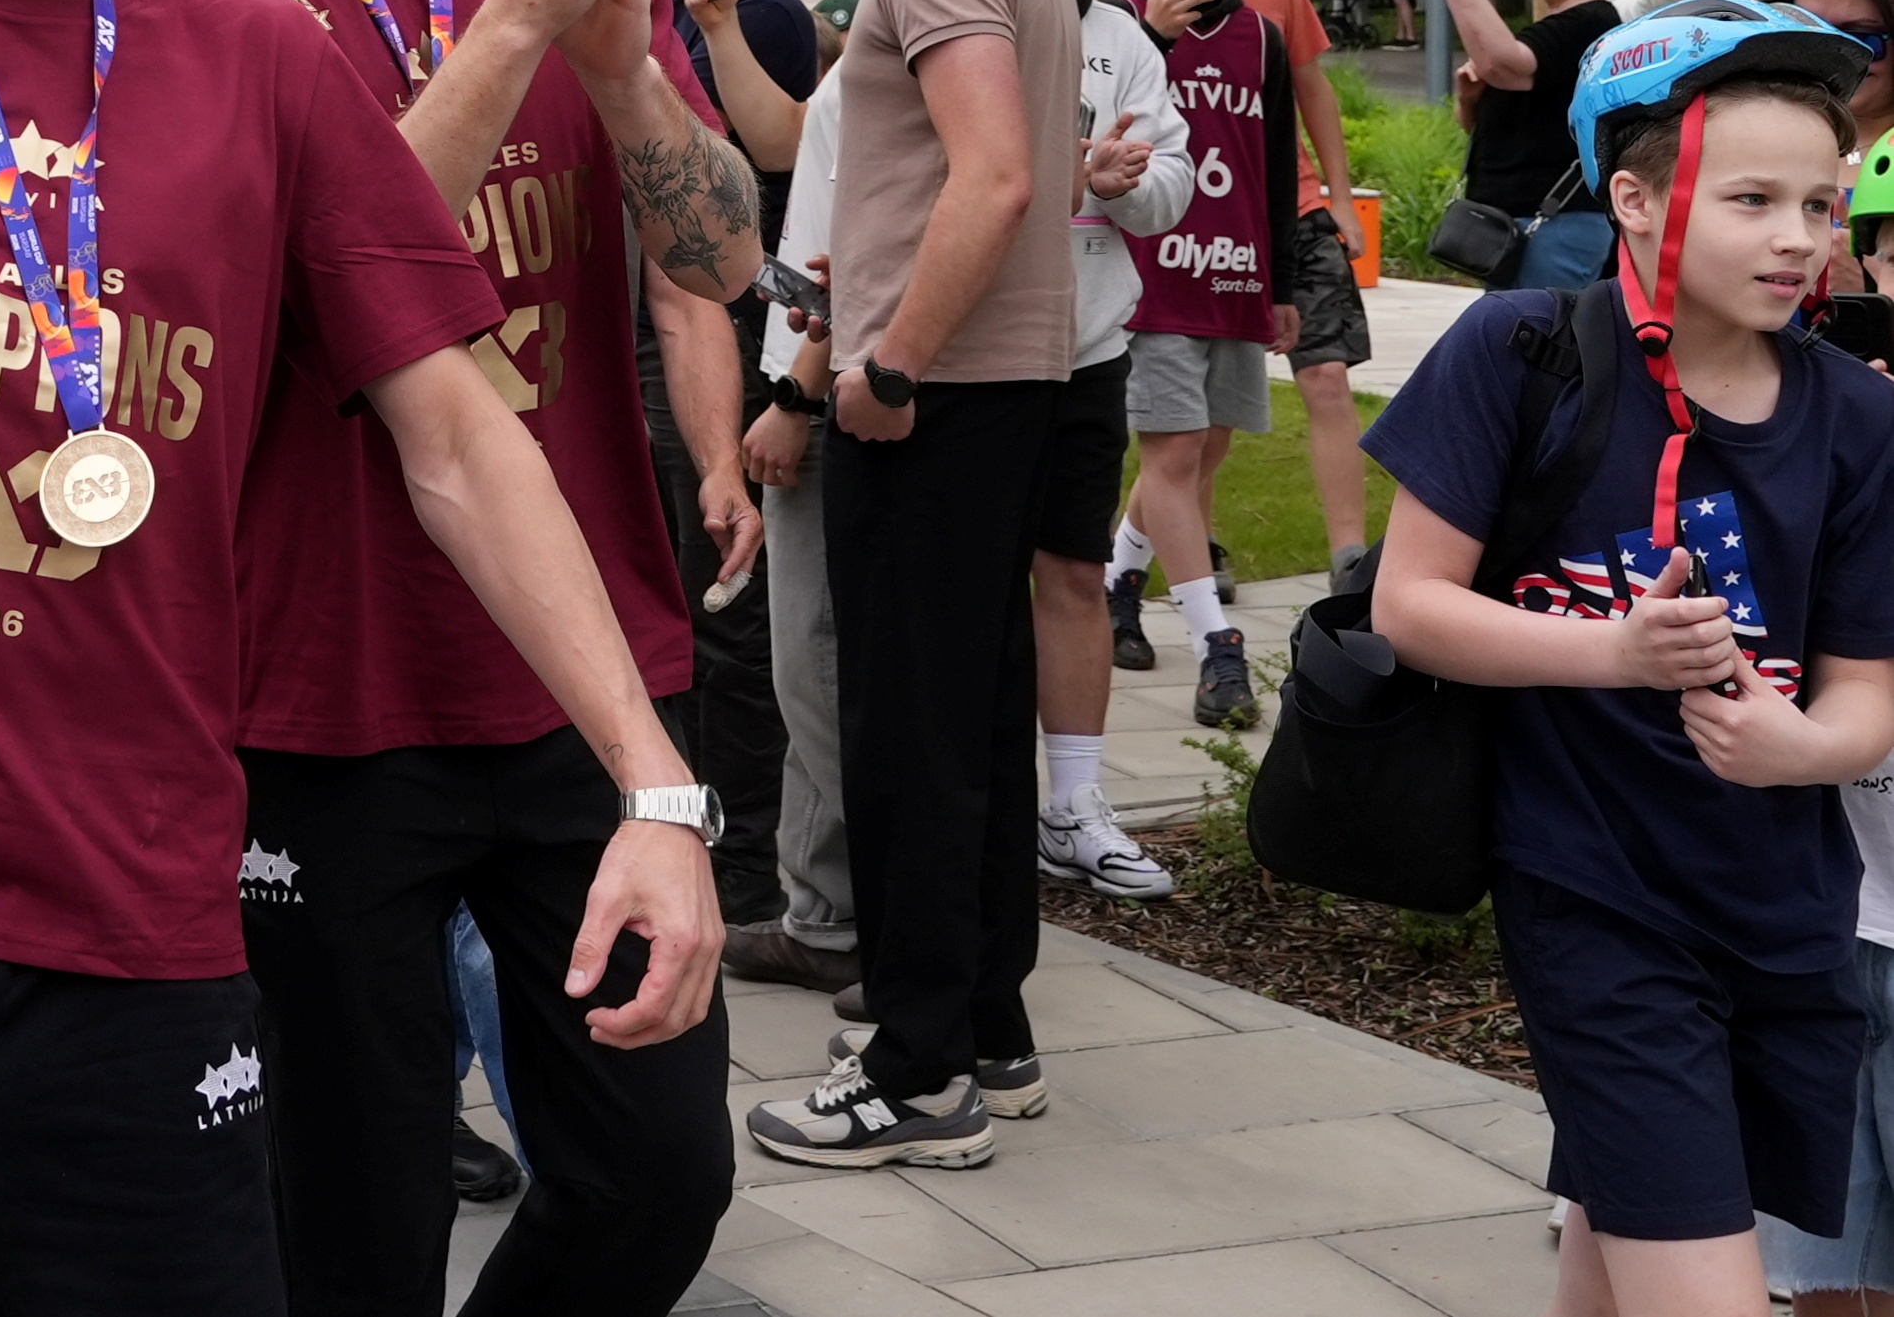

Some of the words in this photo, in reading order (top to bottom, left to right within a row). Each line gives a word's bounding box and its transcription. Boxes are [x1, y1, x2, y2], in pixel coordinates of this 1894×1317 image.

[1609, 36, 1674, 77] SCOTT
[1167, 79, 1264, 121] ATVIJA
[1196, 146, 1234, 199] 6
[1156, 233, 1258, 279] OlyBet
[1209, 276, 1244, 294] Sports
[239, 887, 304, 903] ATVIJA
